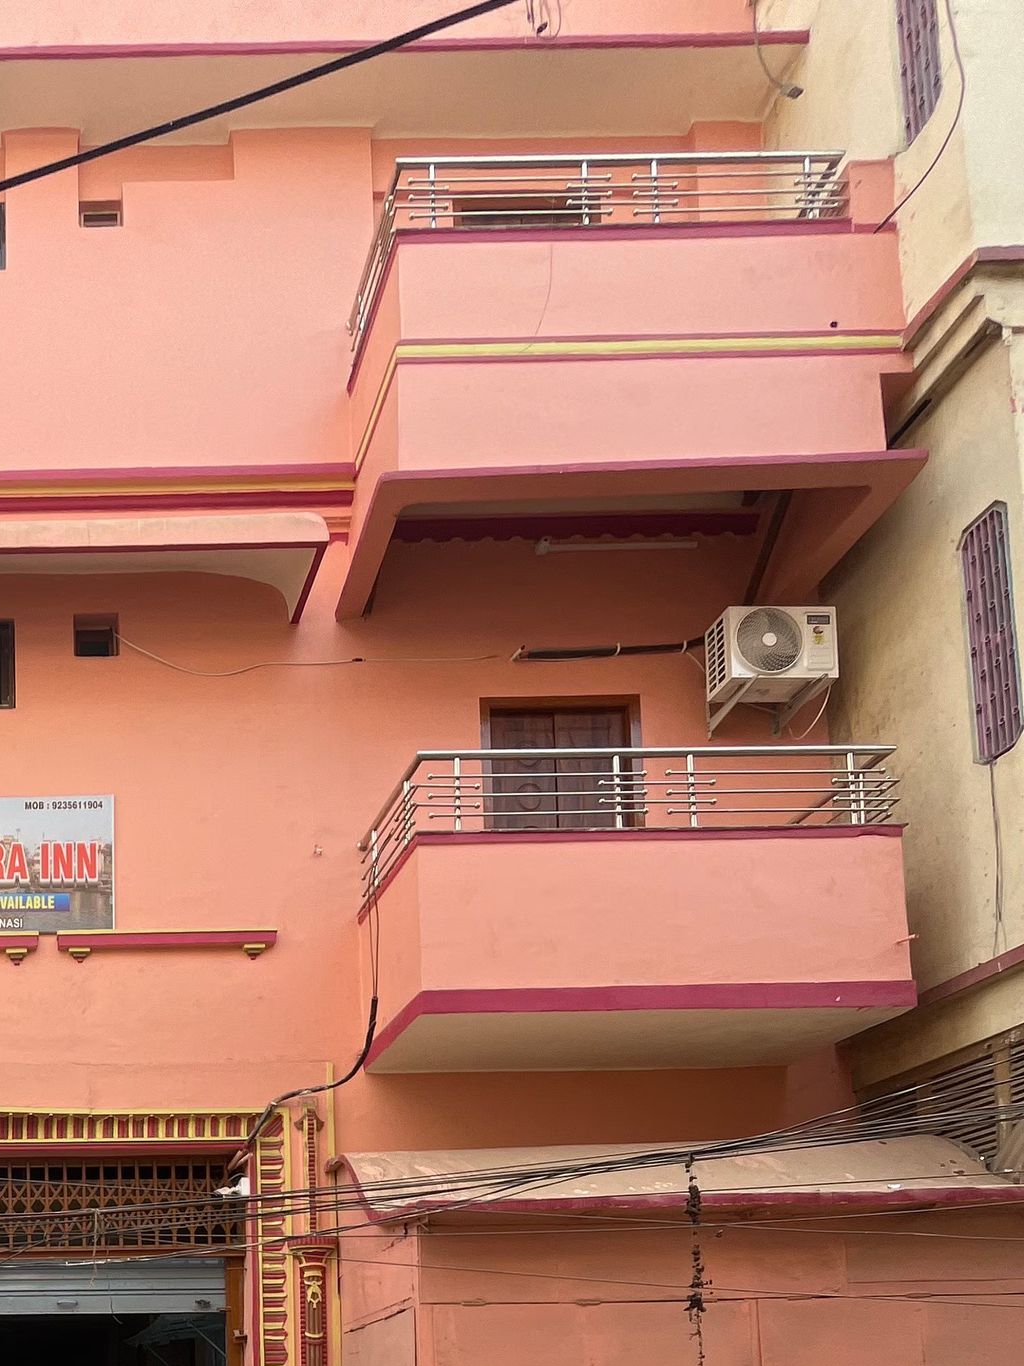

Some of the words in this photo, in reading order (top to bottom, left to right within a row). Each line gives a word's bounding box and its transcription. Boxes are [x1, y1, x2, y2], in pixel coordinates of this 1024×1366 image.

[24, 801, 44, 810] MOB
[52, 800, 103, 809] 9235611904
[39, 841, 99, 884] INN
